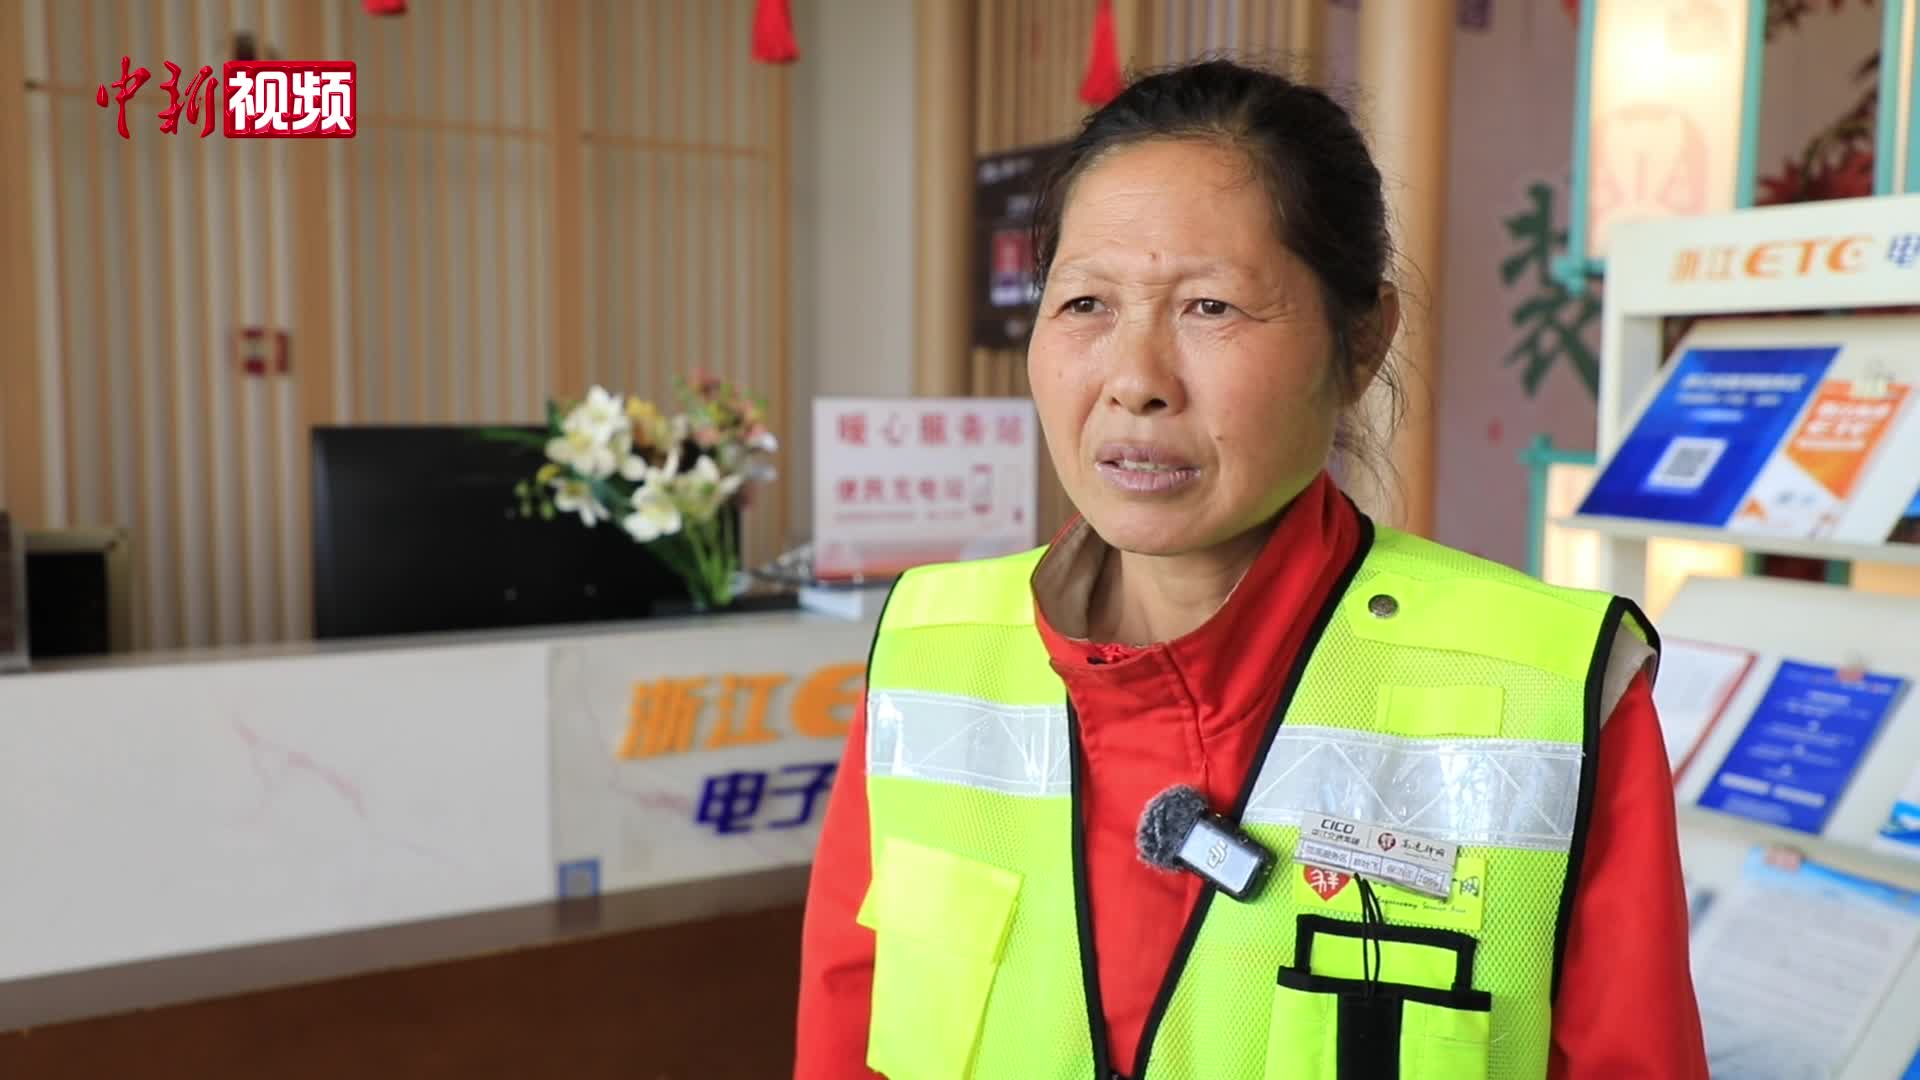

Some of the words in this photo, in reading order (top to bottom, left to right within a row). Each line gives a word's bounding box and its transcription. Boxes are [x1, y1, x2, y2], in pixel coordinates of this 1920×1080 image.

[837, 413, 1024, 446] 暖心服务站
[1320, 818, 1355, 835] CICO
